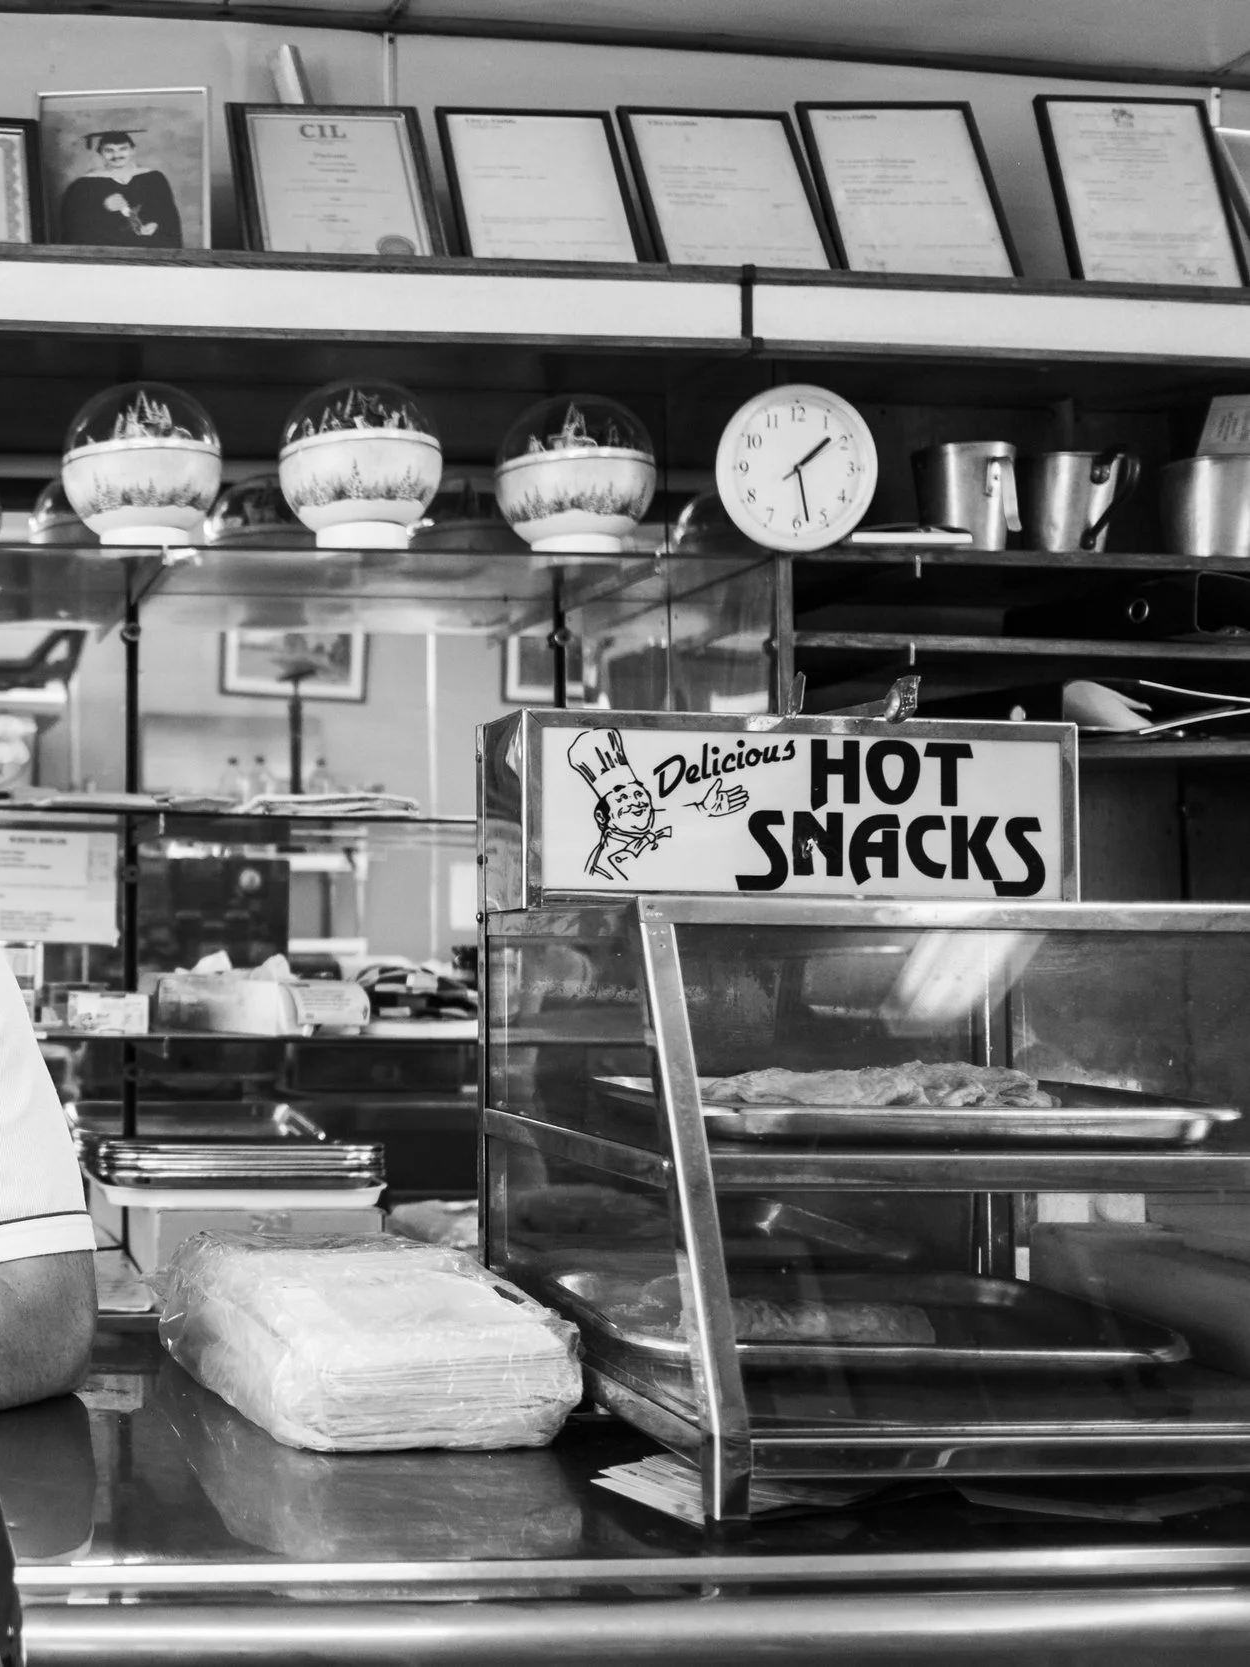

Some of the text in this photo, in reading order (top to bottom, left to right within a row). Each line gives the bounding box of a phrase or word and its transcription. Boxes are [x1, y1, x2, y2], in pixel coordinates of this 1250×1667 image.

[300, 124, 347, 139] CIL
[766, 414, 778, 429] 11
[791, 406, 806, 422] 12
[746, 434, 762, 449] 10
[840, 435, 849, 451] 2
[739, 461, 749, 476] 9
[847, 461, 855, 477] 3
[747, 488, 756, 504] 8
[837, 489, 846, 503] 4
[766, 507, 775, 523] 7
[792, 515, 802, 530] 6
[819, 508, 828, 524] 5
[653, 739, 797, 798] Delicious
[811, 739, 974, 811] HOT
[735, 810, 1047, 897] SNACKS
